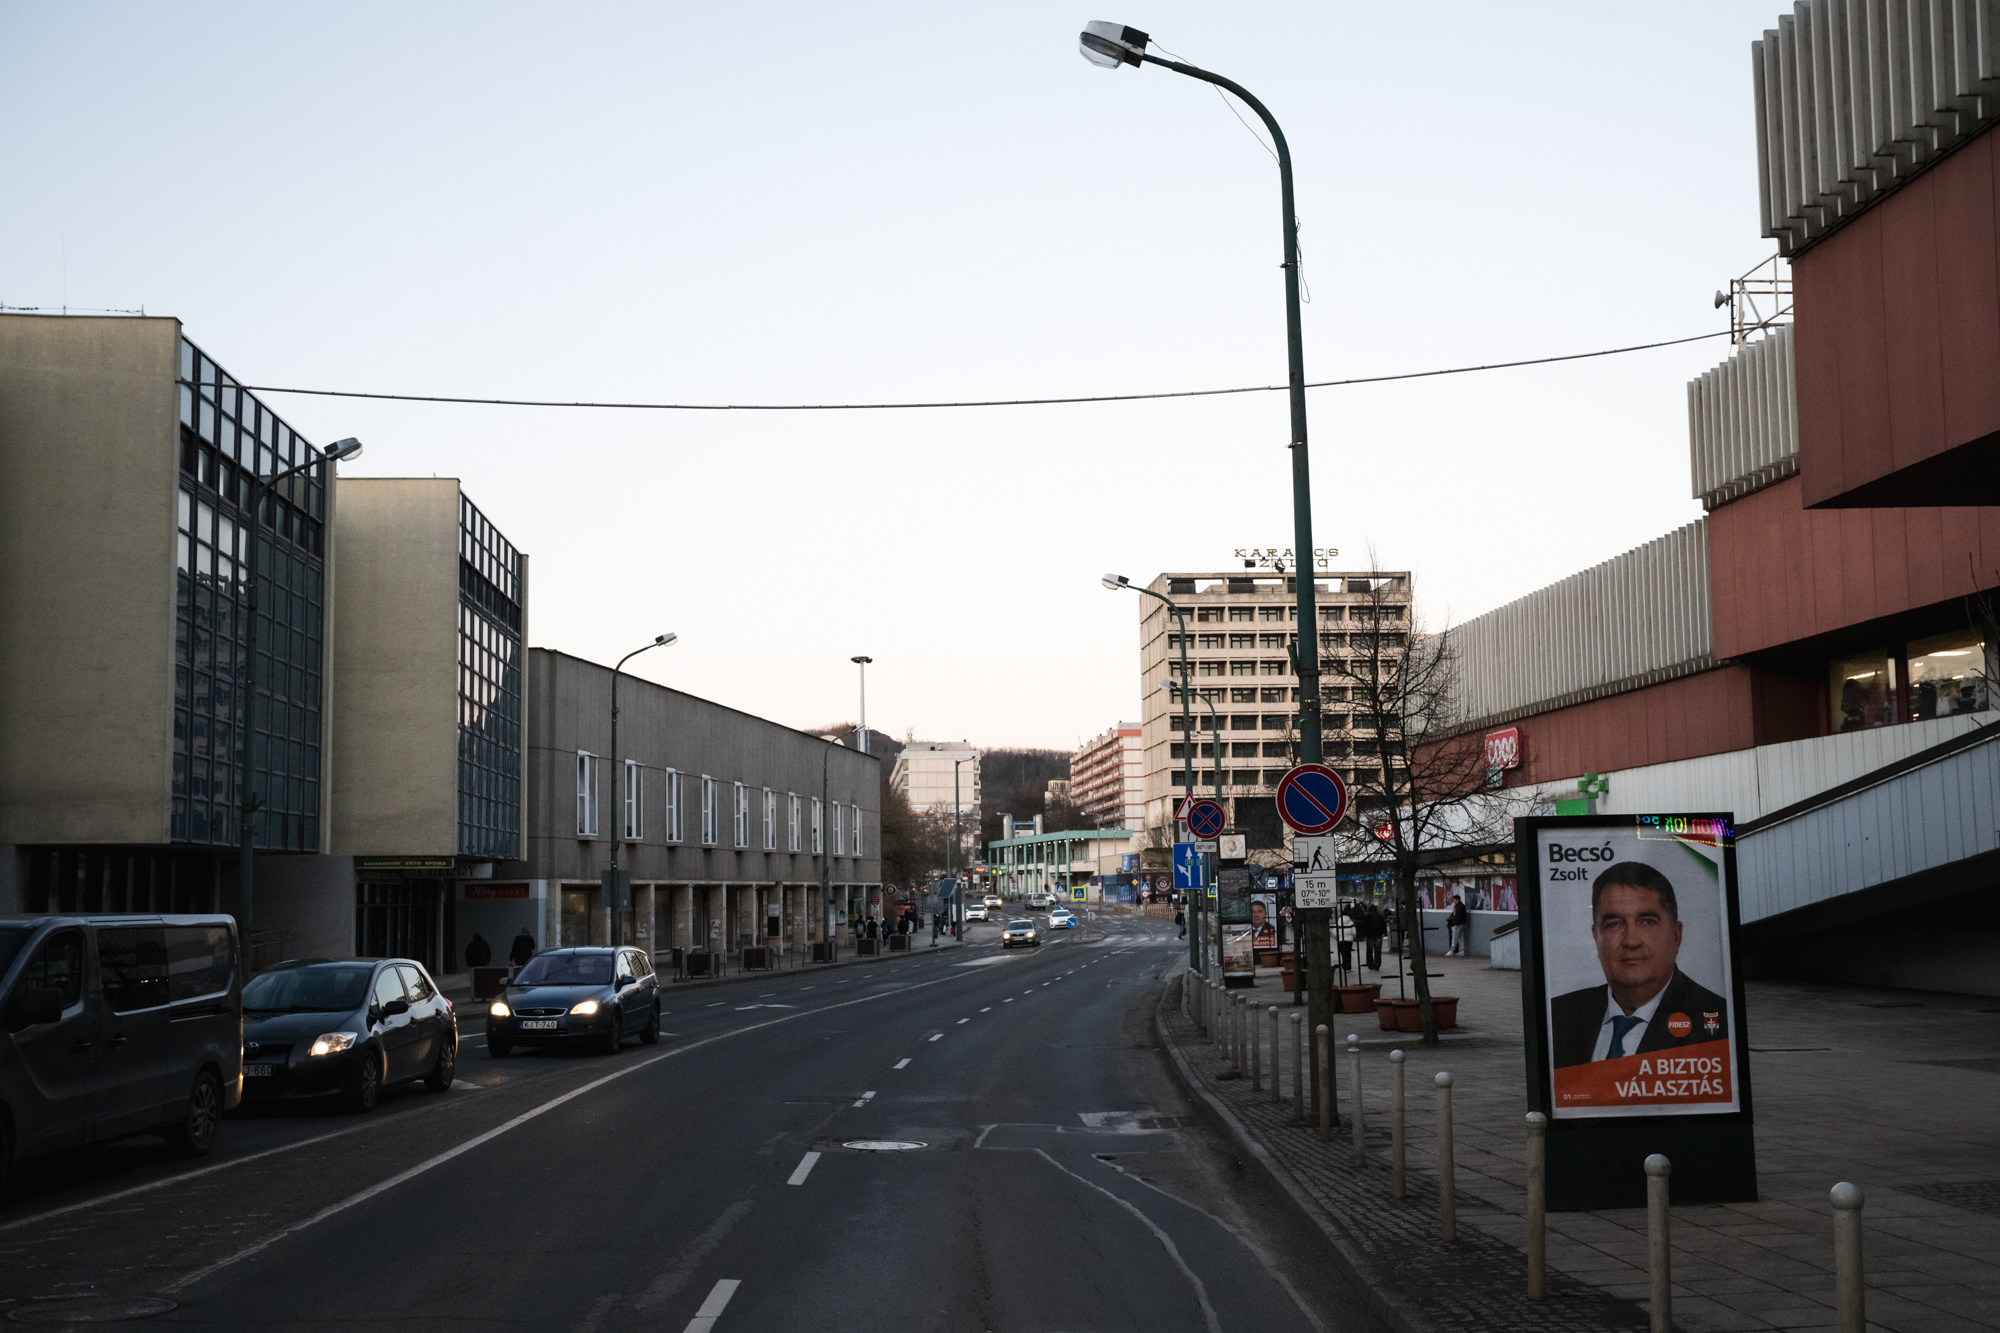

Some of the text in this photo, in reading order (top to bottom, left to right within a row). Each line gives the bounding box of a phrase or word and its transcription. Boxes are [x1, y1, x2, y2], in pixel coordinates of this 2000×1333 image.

[1234, 548, 1339, 558] KARACS
[1245, 557, 1328, 568] ZÁLÓ
[1548, 840, 1615, 864] Becsó
[1549, 867, 1589, 882] Zsolt
[1305, 880, 1326, 889] 15 m
[1668, 1021, 1691, 1029] FIDESZ
[1639, 1057, 1722, 1076] A BIZTOS
[1615, 1074, 1724, 1098] VÁLASZTÁS
